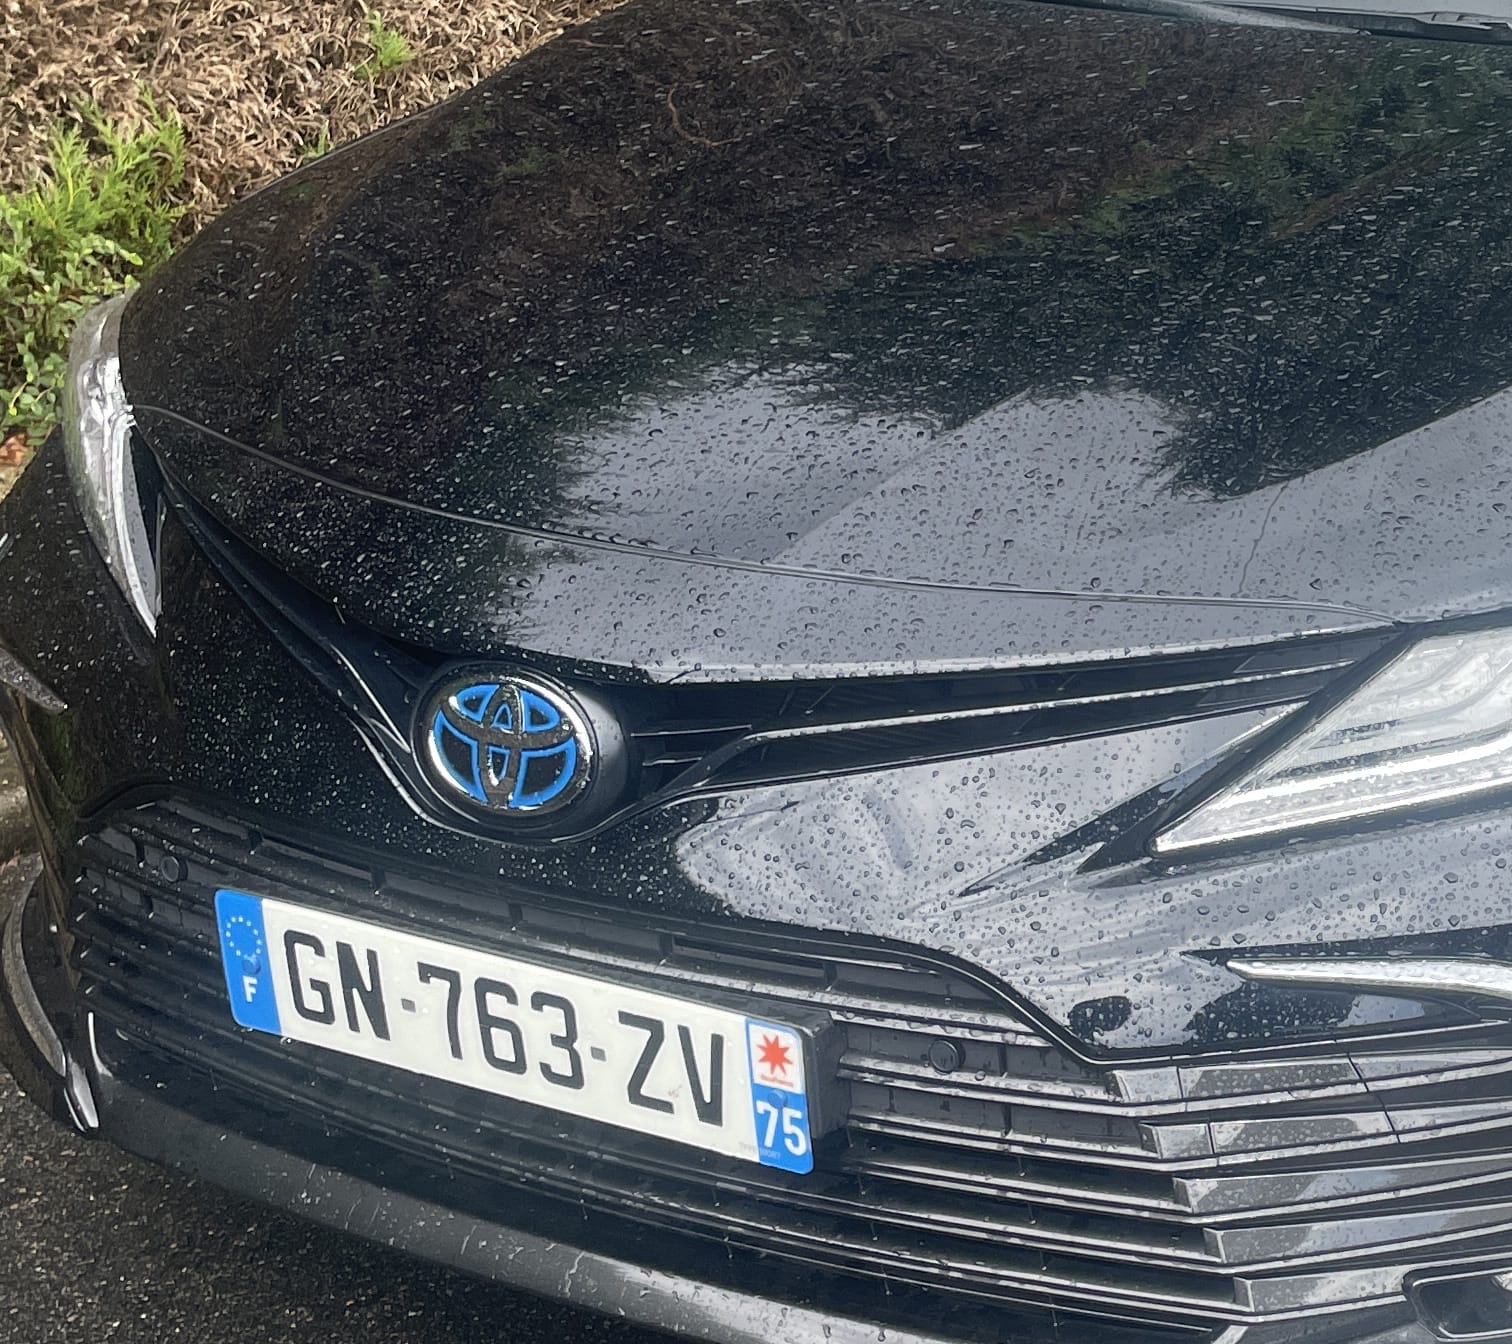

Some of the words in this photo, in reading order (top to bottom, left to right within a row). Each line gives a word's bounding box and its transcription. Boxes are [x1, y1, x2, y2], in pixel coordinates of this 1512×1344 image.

[242, 975, 258, 1003] F
[283, 930, 725, 1127] GN-763-ZV
[755, 1100, 807, 1156] 75
